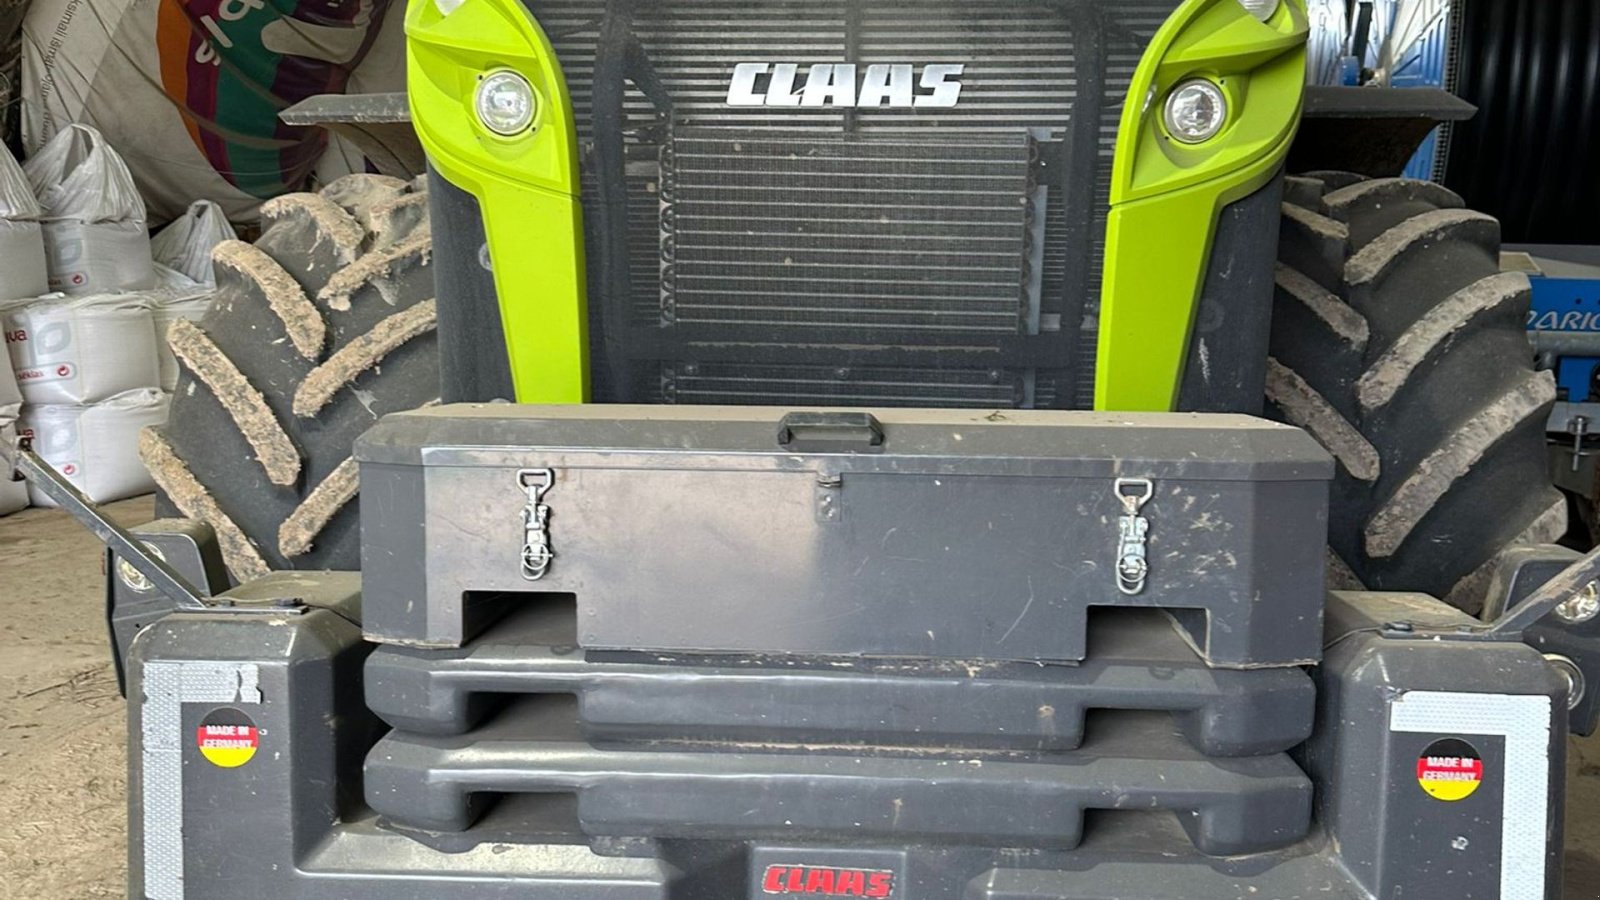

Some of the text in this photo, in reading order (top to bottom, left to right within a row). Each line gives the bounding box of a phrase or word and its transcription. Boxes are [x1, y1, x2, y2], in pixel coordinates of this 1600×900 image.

[727, 63, 965, 108] CLAAS
[206, 725, 250, 736] MADE IN
[203, 739, 253, 749] GERMANY
[1427, 757, 1474, 768] MADE IN
[1423, 771, 1477, 781] GERMANY
[763, 866, 893, 898] CLAAS
